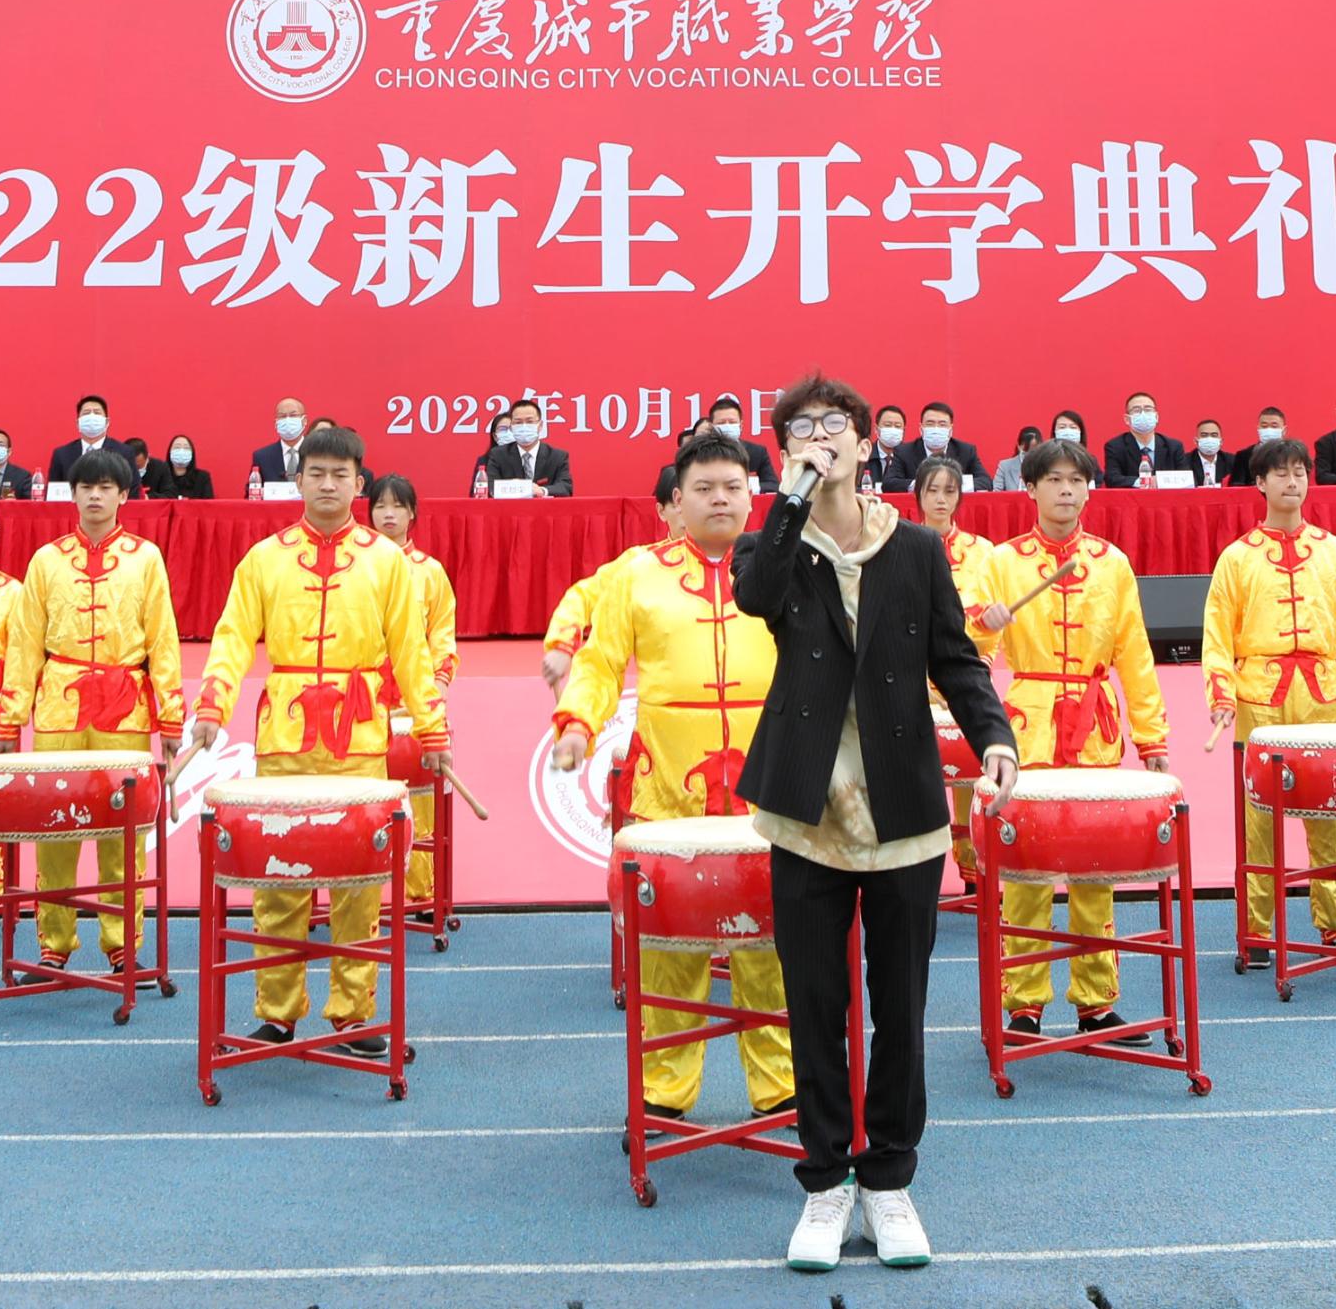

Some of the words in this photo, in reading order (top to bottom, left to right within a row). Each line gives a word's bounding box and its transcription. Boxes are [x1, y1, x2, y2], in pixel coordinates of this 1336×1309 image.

[375, 68, 550, 89] CHONGQING
[558, 68, 621, 89] CITY
[628, 68, 805, 89] VOCATIONAL
[812, 67, 942, 88] COLLEGE
[386, 386, 786, 439] 2022年10月1日
